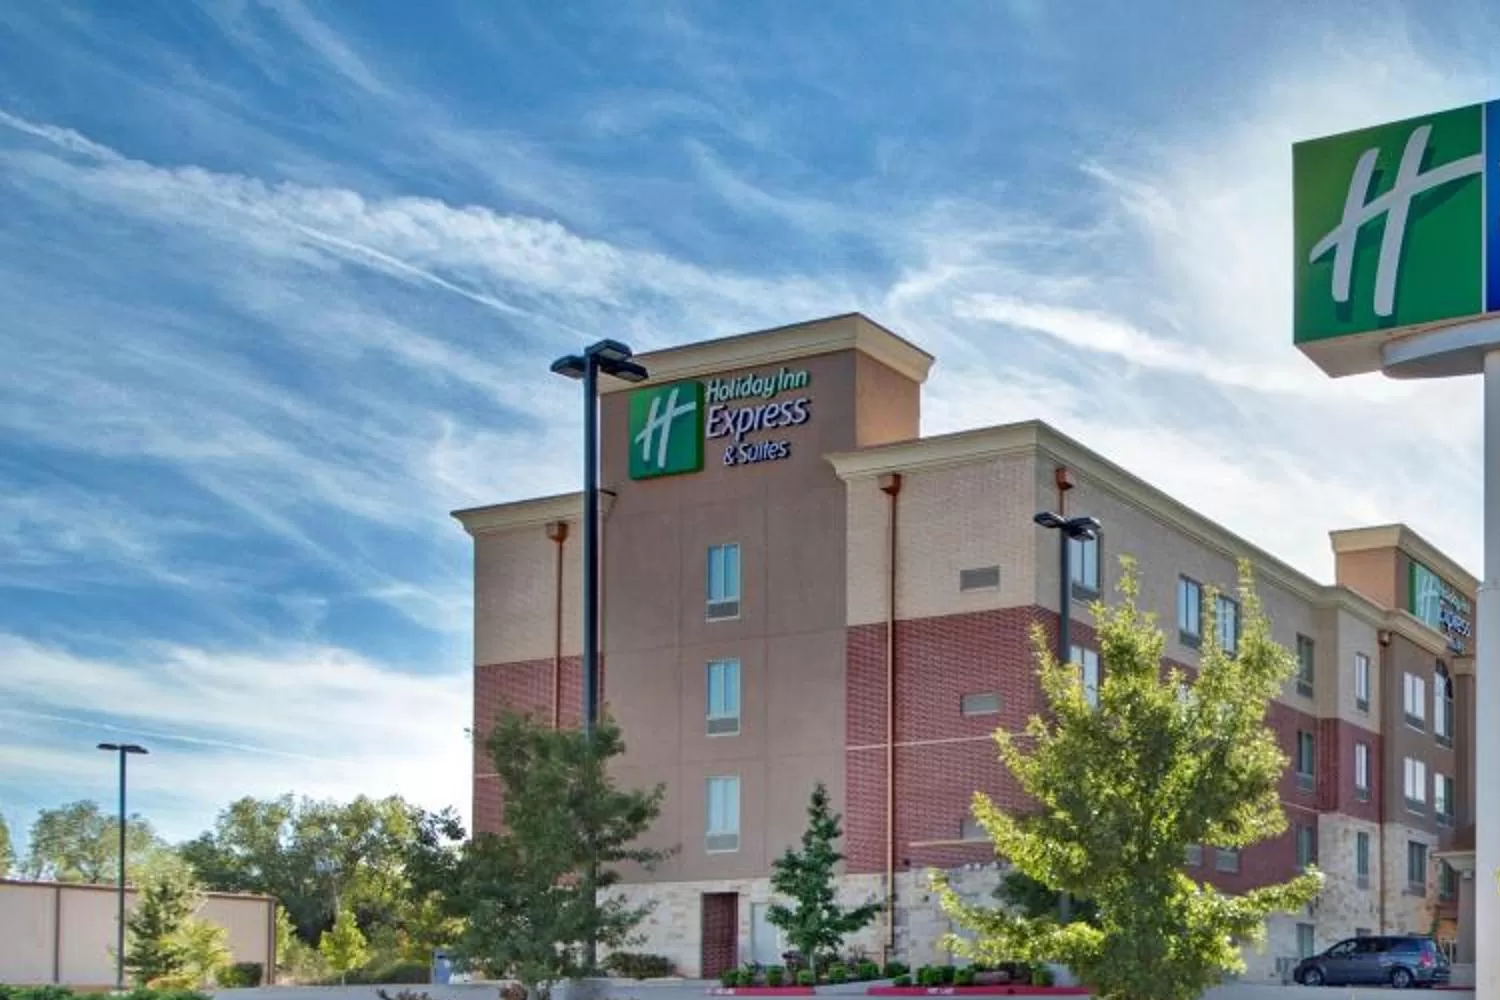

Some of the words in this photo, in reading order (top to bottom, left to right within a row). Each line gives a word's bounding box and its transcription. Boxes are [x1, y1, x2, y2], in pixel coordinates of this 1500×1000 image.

[706, 373, 775, 403] Holiday
[778, 367, 808, 390] Inn
[706, 397, 809, 441] Express
[724, 445, 736, 465] &
[739, 440, 788, 462] Suites
